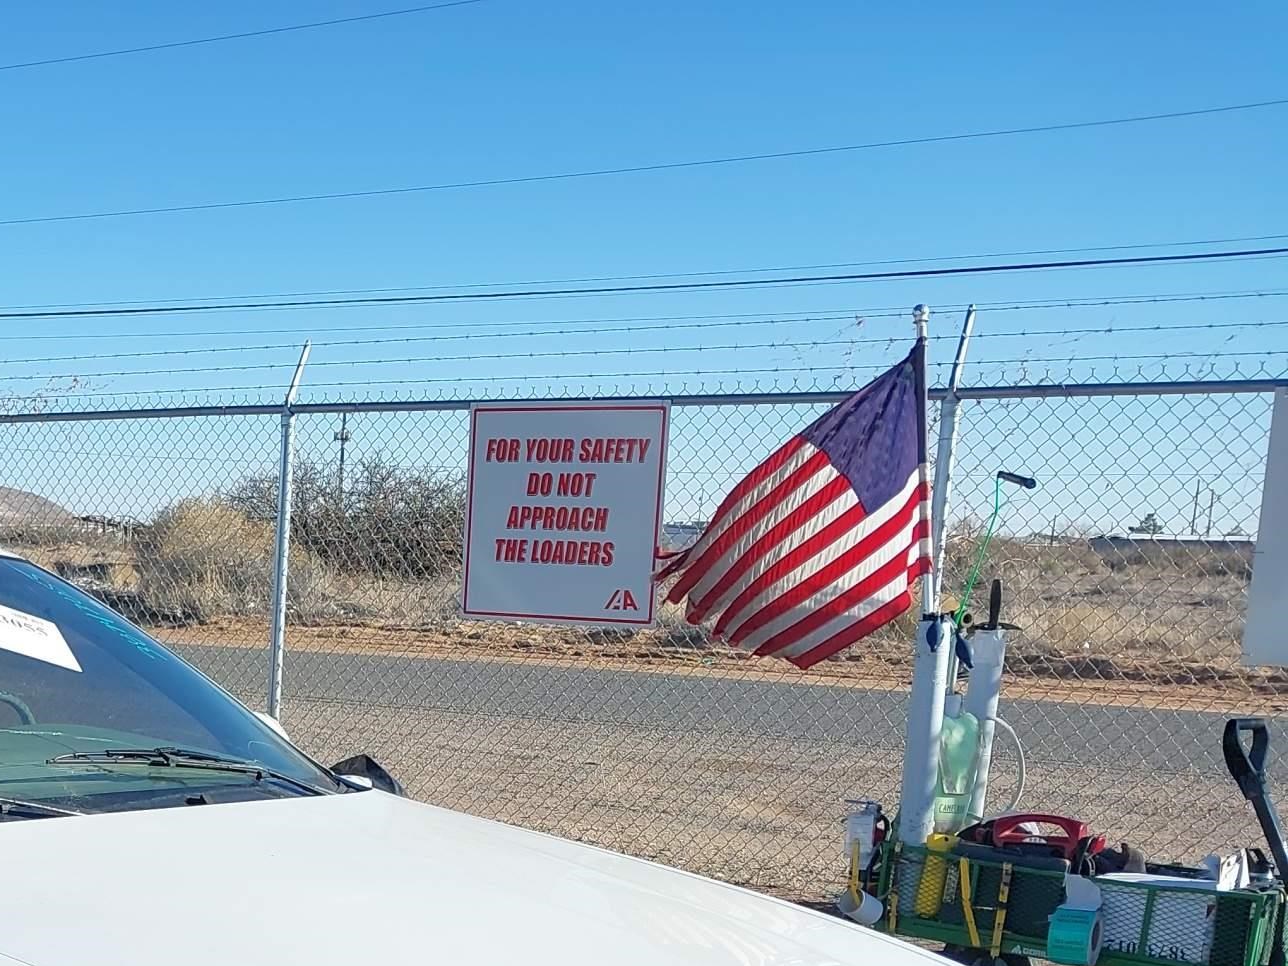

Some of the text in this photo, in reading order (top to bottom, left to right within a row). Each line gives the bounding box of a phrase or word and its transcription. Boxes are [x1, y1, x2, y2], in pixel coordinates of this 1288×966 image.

[486, 439, 651, 463] FOR YOUR SAFETY
[527, 473, 596, 497] DO NOT
[507, 506, 609, 532] APPROACH
[495, 539, 615, 566] THE LOADERS
